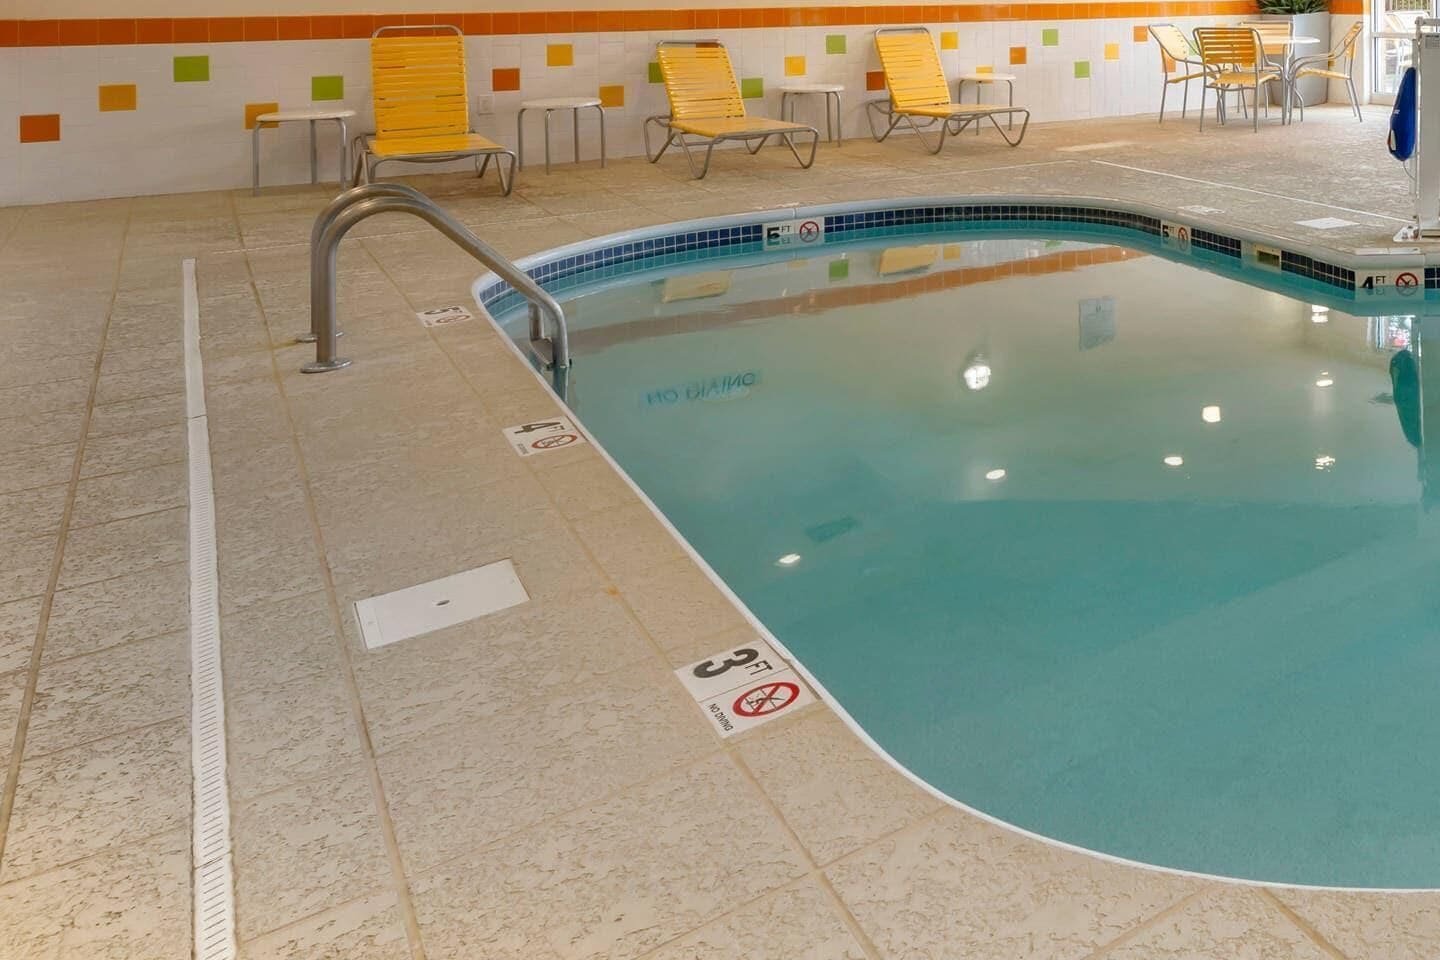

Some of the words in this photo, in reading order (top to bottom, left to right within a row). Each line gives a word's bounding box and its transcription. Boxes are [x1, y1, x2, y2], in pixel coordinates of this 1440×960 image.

[1376, 276, 1386, 284] FT
[693, 648, 759, 679] 3
[744, 660, 773, 676] FT
[709, 703, 720, 714] NO
[715, 711, 734, 732] DIVING
